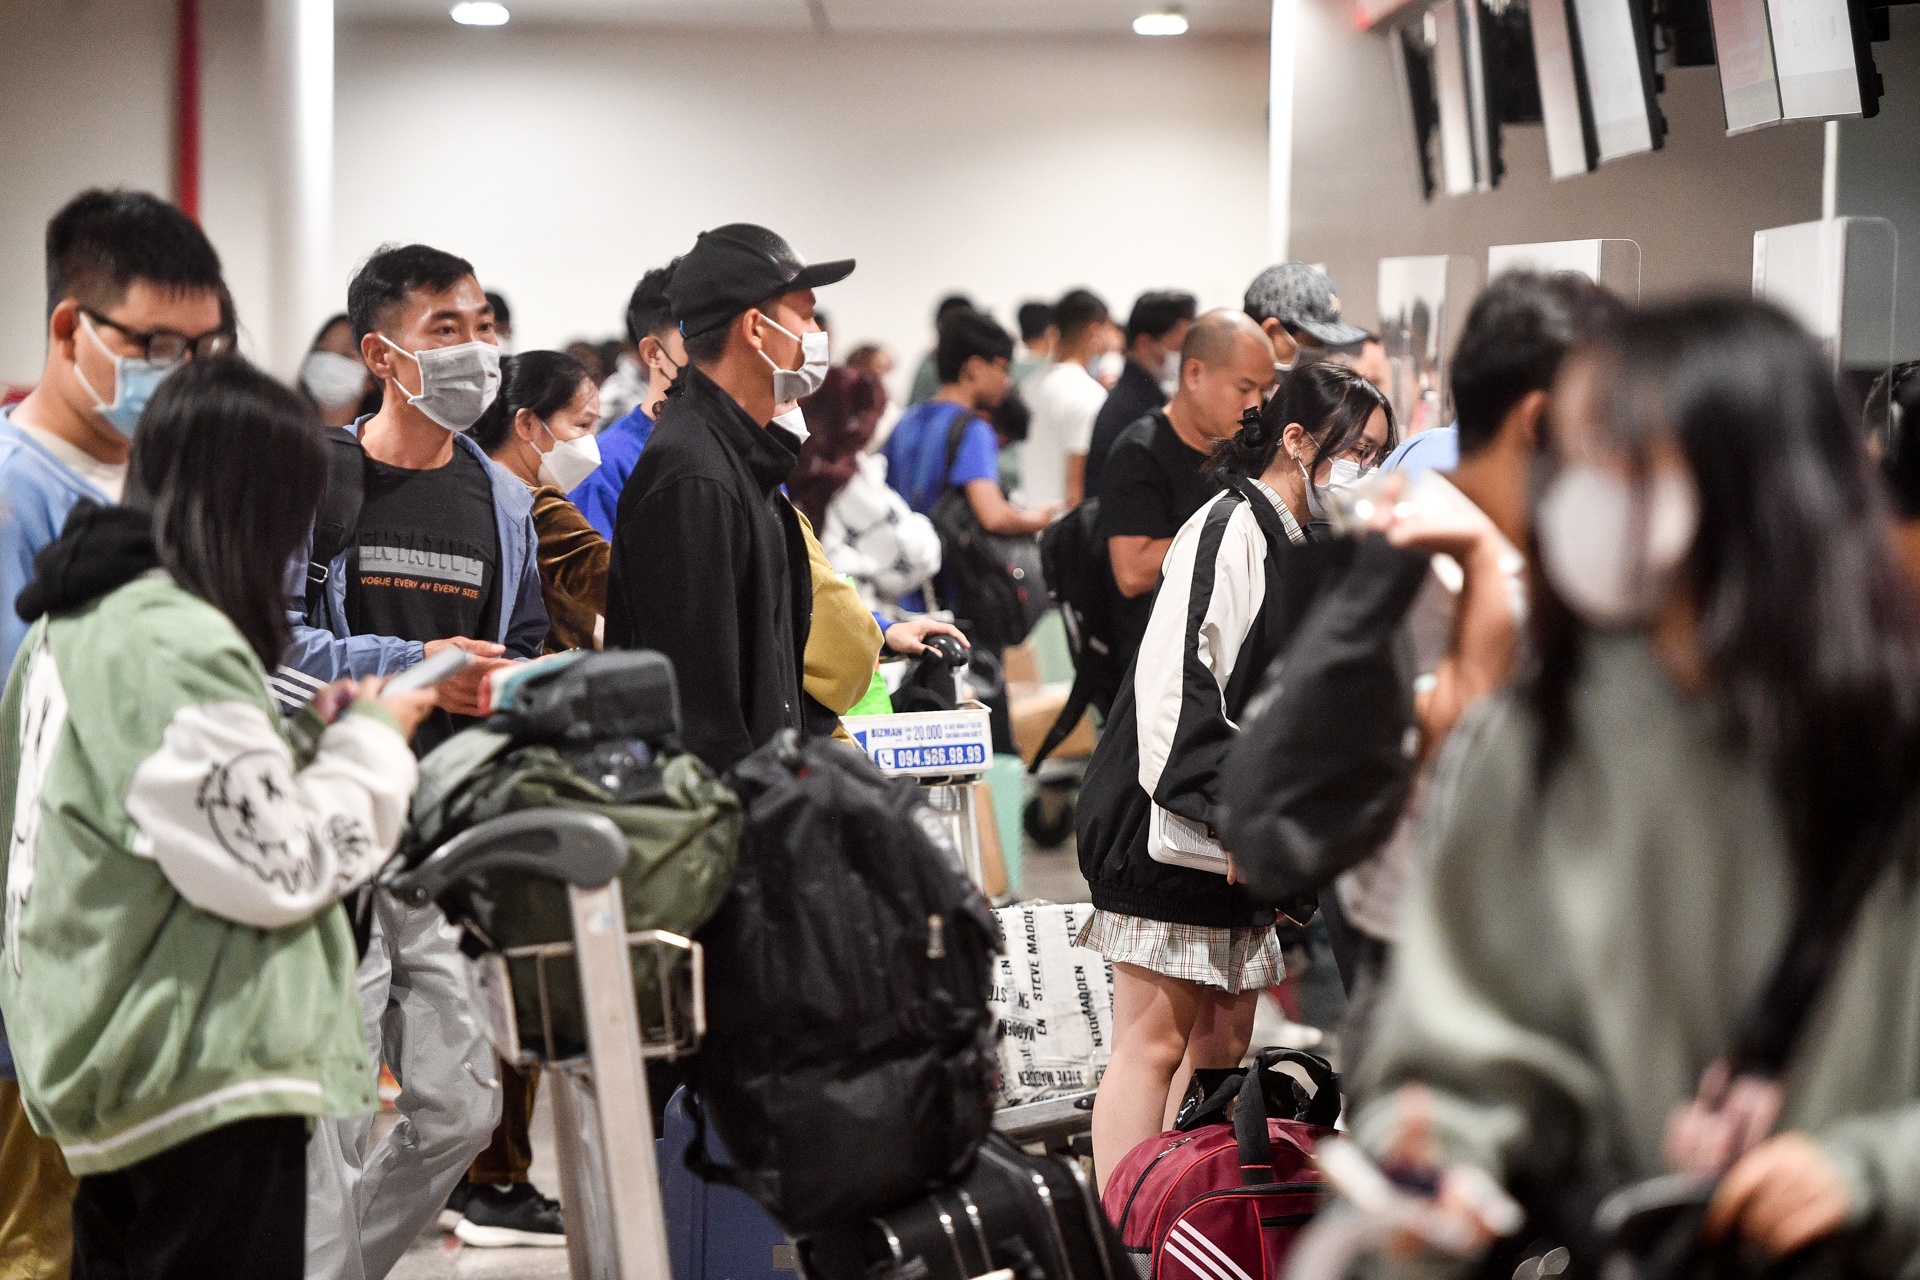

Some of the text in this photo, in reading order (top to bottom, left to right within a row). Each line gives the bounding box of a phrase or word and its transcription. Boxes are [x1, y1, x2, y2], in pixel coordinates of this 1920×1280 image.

[360, 576, 391, 587] VOGUE
[394, 578, 418, 589] EVERY
[433, 583, 460, 594] EVERY
[462, 588, 479, 599] SIZE
[1064, 908, 1077, 948] STEVE
[1028, 960, 1043, 1002] STEVE
